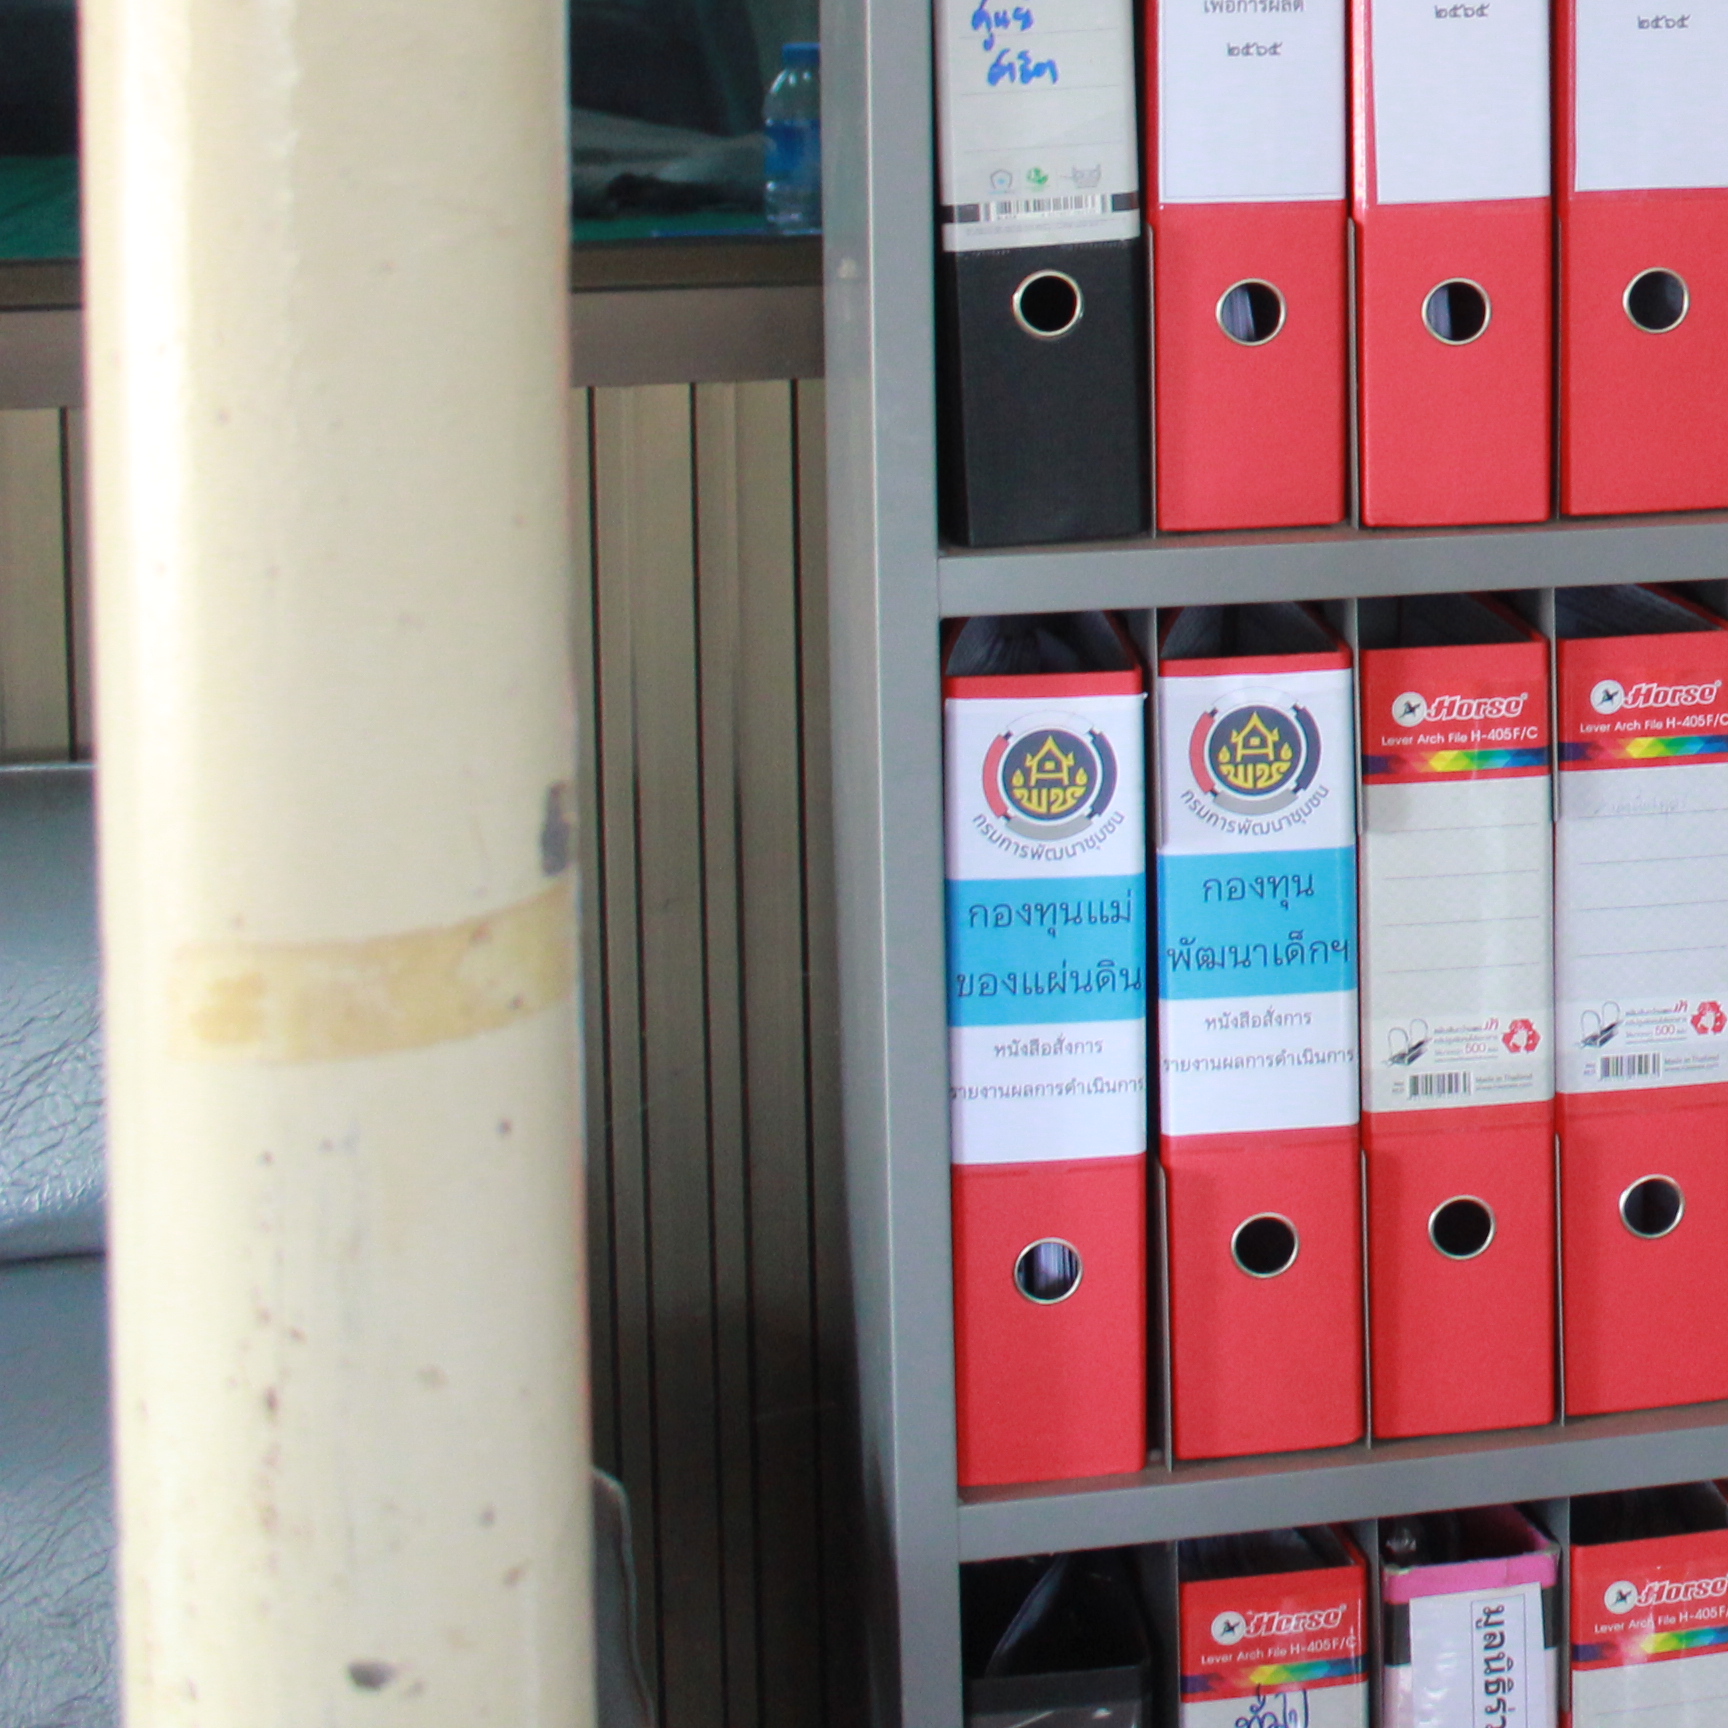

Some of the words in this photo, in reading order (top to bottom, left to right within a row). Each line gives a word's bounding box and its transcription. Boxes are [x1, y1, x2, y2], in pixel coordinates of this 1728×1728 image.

[1434, 2, 1489, 19] ๒๕๖๕
[1637, 14, 1690, 30] ๒๕๖๕
[1226, 40, 1283, 58] ๒๕๖๕
[1425, 694, 1522, 722] Horse
[1624, 681, 1717, 710] Horse
[1381, 734, 1413, 748] Lever
[1416, 732, 1445, 745] Arch
[1448, 731, 1468, 743] File
[1470, 726, 1538, 743] H-405F/C
[1580, 720, 1611, 734] Lever
[1613, 718, 1642, 731] Arch
[1644, 716, 1663, 729] File
[1180, 783, 1330, 836] กรมการพัฒนาชุมชน
[972, 807, 1126, 862] กรมการพัฒนาชุมชน
[1202, 873, 1315, 912] กองทุน
[968, 890, 1133, 937] กองทุนแม่
[1167, 931, 1350, 969] พัฒนาเด็กฯ
[956, 959, 1142, 999] ของแผ่นดิน
[1205, 1007, 1312, 1032] หนังสือสั่งการ
[1654, 1025, 1676, 1036] 500
[993, 1032, 1103, 1059] หนังสือสั่งการ
[1465, 1042, 1486, 1054] 500
[1164, 1046, 1355, 1072] รายงานผลการดำเนินการ
[951, 1075, 1145, 1101] รายงานผลการดำเนินการ
[1637, 1576, 1726, 1607] Horse
[1245, 1609, 1341, 1636] Horse
[1594, 1622, 1624, 1635] Lever
[1628, 1618, 1653, 1631] Arch
[1657, 1614, 1676, 1627] File
[1201, 1652, 1233, 1666] Lever
[1236, 1649, 1264, 1661] Arch
[1268, 1646, 1287, 1659] File
